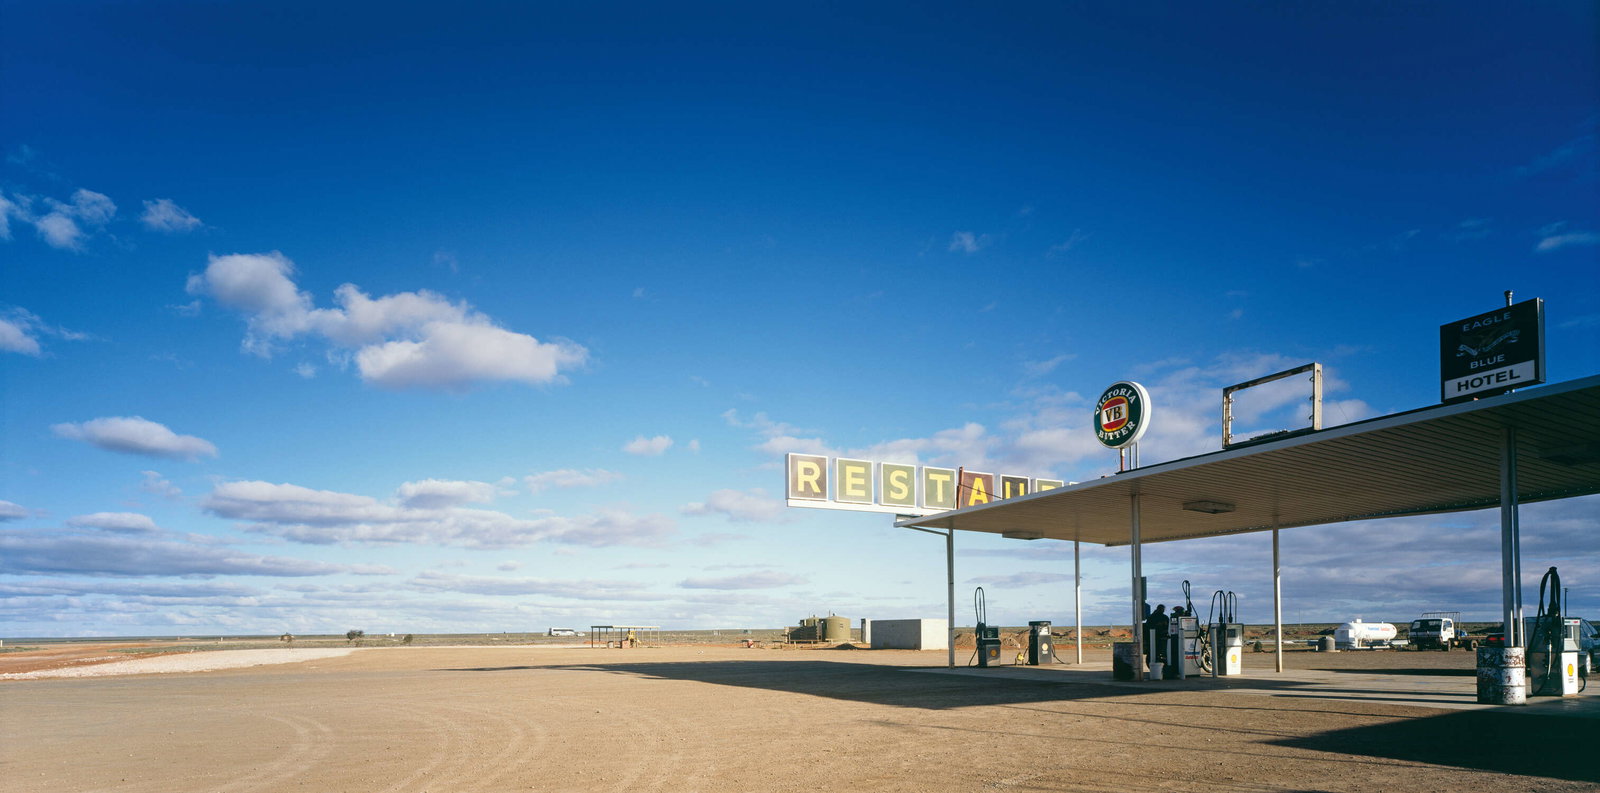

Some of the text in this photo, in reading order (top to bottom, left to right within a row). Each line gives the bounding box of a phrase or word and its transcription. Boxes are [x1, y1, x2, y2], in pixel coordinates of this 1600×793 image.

[1463, 312, 1511, 332] EAGLE
[1470, 354, 1505, 369] BLUE
[1457, 369, 1521, 392] HOTEL
[1095, 388, 1137, 415] VICTORIA
[1105, 406, 1123, 422] VB
[1098, 421, 1136, 440] BITTER
